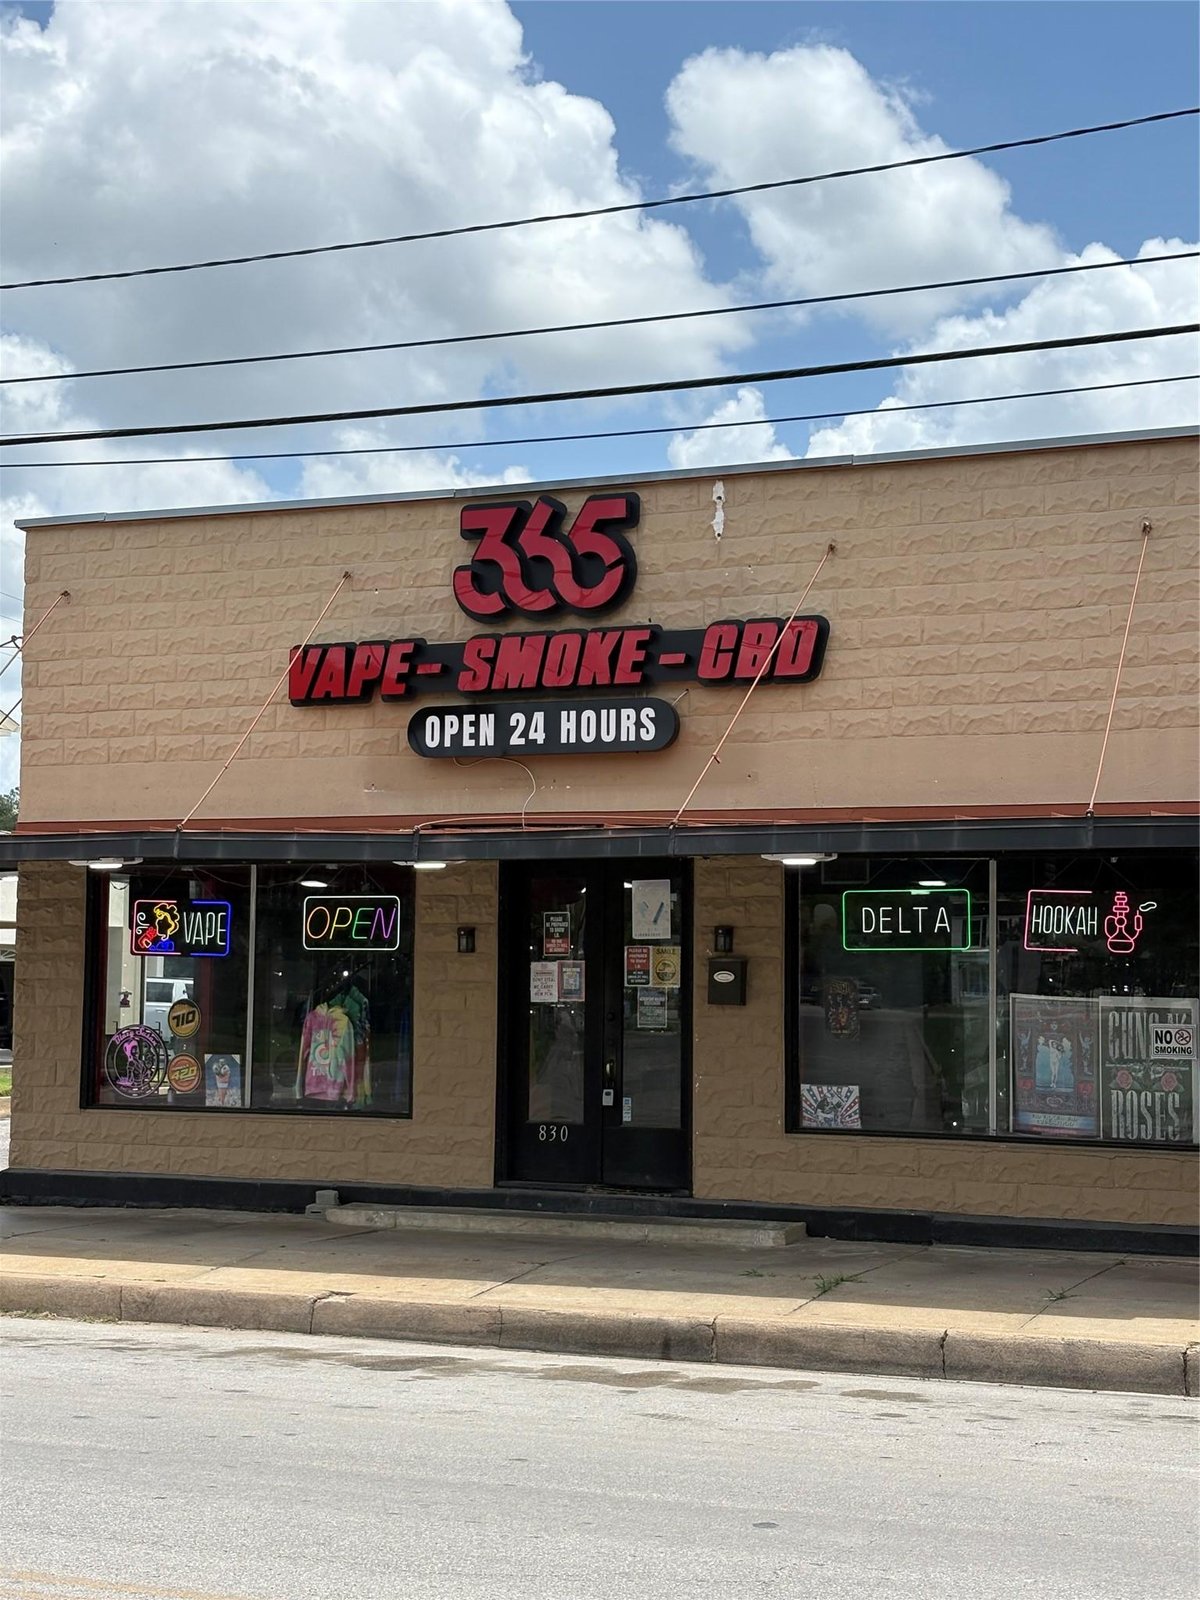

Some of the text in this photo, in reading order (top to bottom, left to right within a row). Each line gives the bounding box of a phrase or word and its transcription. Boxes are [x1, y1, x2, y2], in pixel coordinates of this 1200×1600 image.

[453, 496, 627, 614] 365
[457, 629, 651, 692] SMOKE
[698, 619, 819, 680] CBD
[424, 707, 657, 748] OPEN 24 HOURS
[183, 911, 227, 946] VAPE
[306, 905, 398, 940] OPEN
[861, 906, 951, 934] DELTA
[1031, 904, 1098, 936] HOOKAH
[172, 1010, 196, 1027] 710
[1154, 1046, 1193, 1055] SMOKING
[1155, 1030, 1173, 1045] NO
[171, 1066, 197, 1081] 420
[1111, 1089, 1180, 1141] ROSES
[538, 1124, 569, 1142] 830
